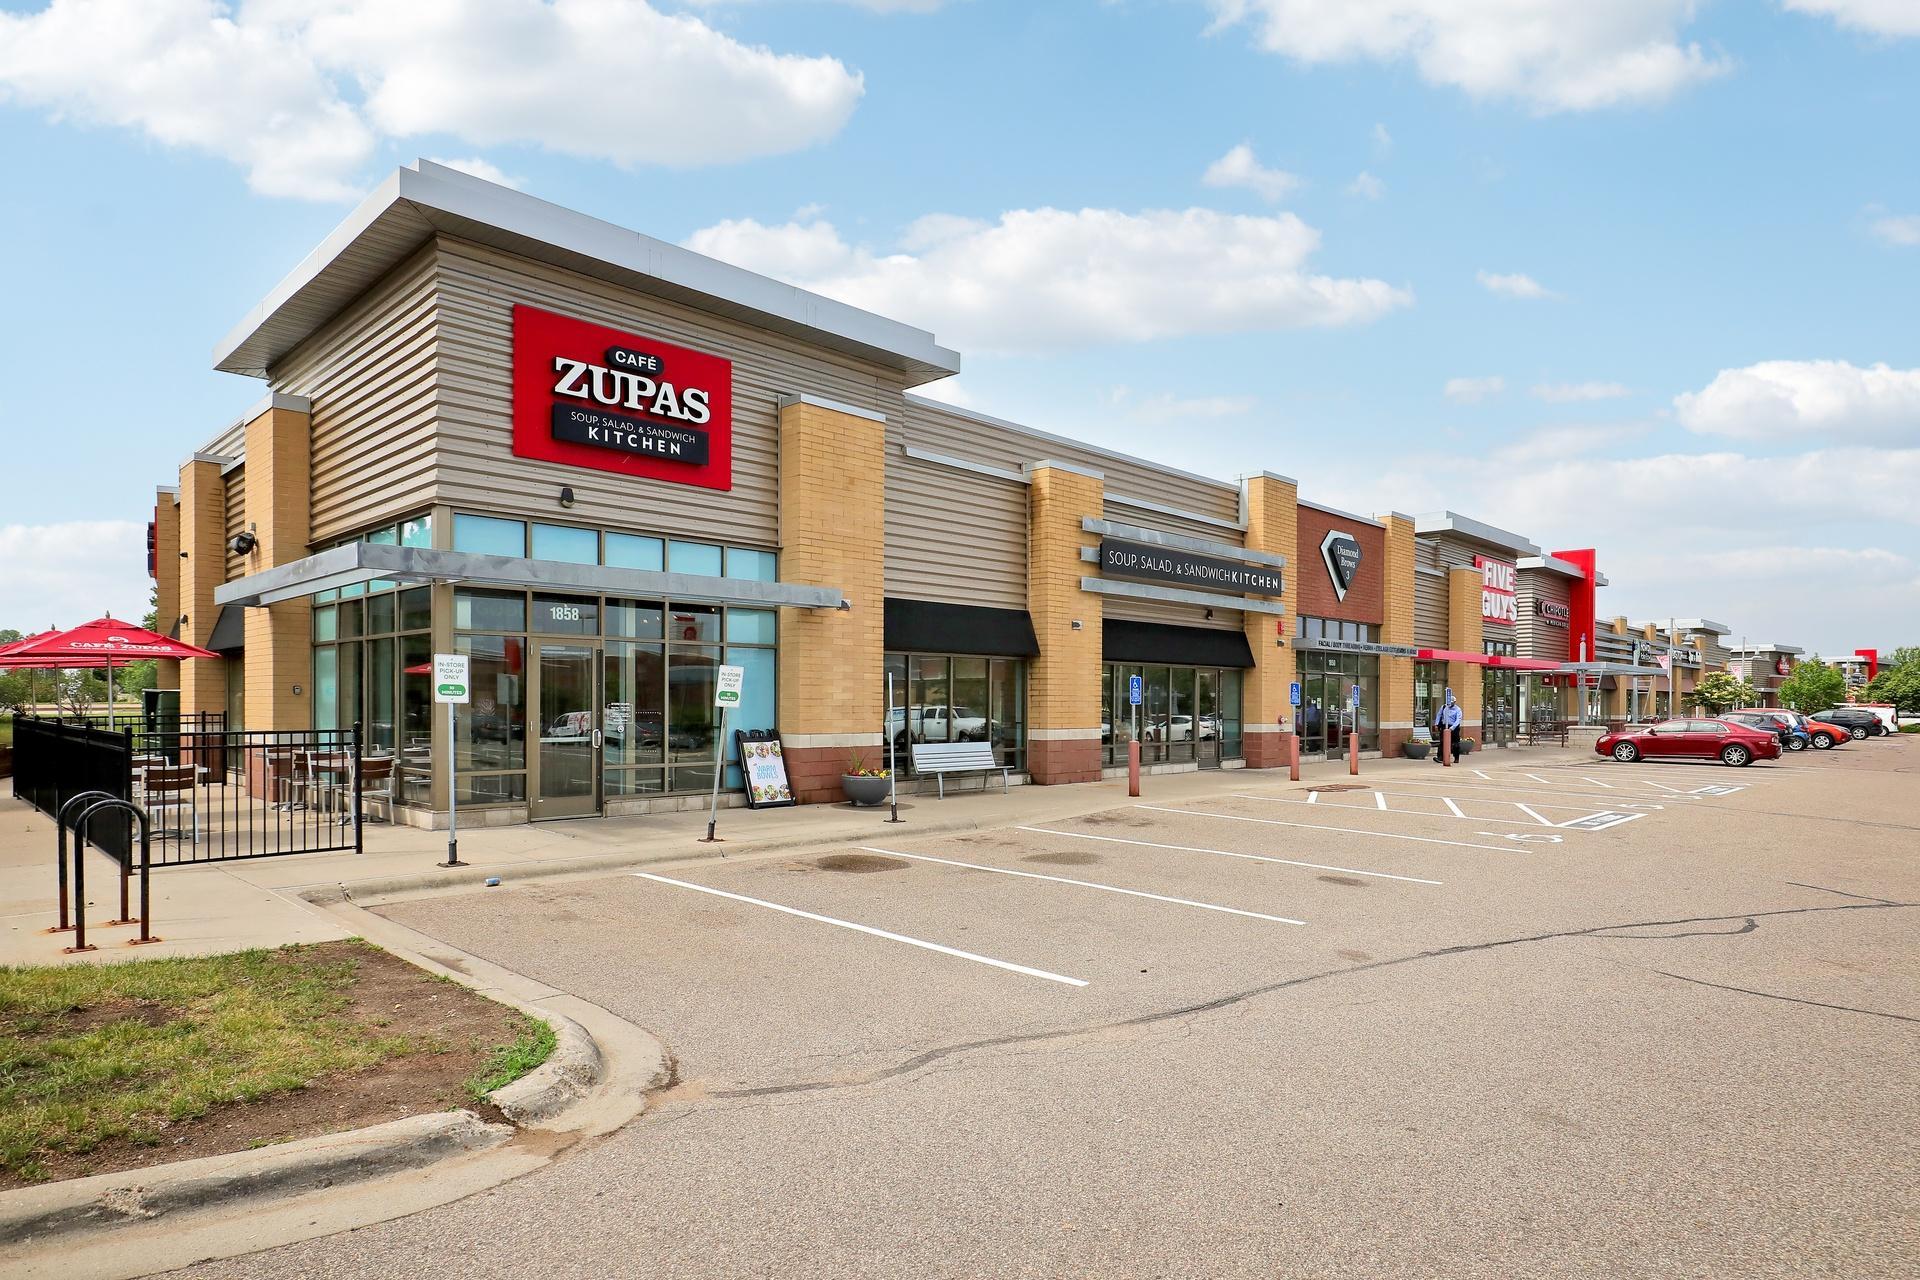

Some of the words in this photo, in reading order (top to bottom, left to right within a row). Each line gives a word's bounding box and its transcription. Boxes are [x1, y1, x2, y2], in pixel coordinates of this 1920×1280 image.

[615, 350, 657, 371] CAFÉ
[554, 356, 711, 424] ZUPAS
[571, 411, 600, 426] SOUP,
[602, 418, 636, 433] SALAD,
[646, 427, 696, 444] SANDWICH
[588, 426, 681, 455] KITCHEN
[1337, 544, 1359, 558] Diamond
[1109, 550, 1138, 569] SOUP,
[1140, 555, 1174, 574] SALAD,
[1176, 564, 1182, 574] &
[1231, 571, 1278, 589] KITCHEN
[1345, 570, 1350, 580] 3
[1484, 559, 1515, 592] FIVE
[550, 606, 579, 621] 1858
[1482, 590, 1518, 622] GUYS
